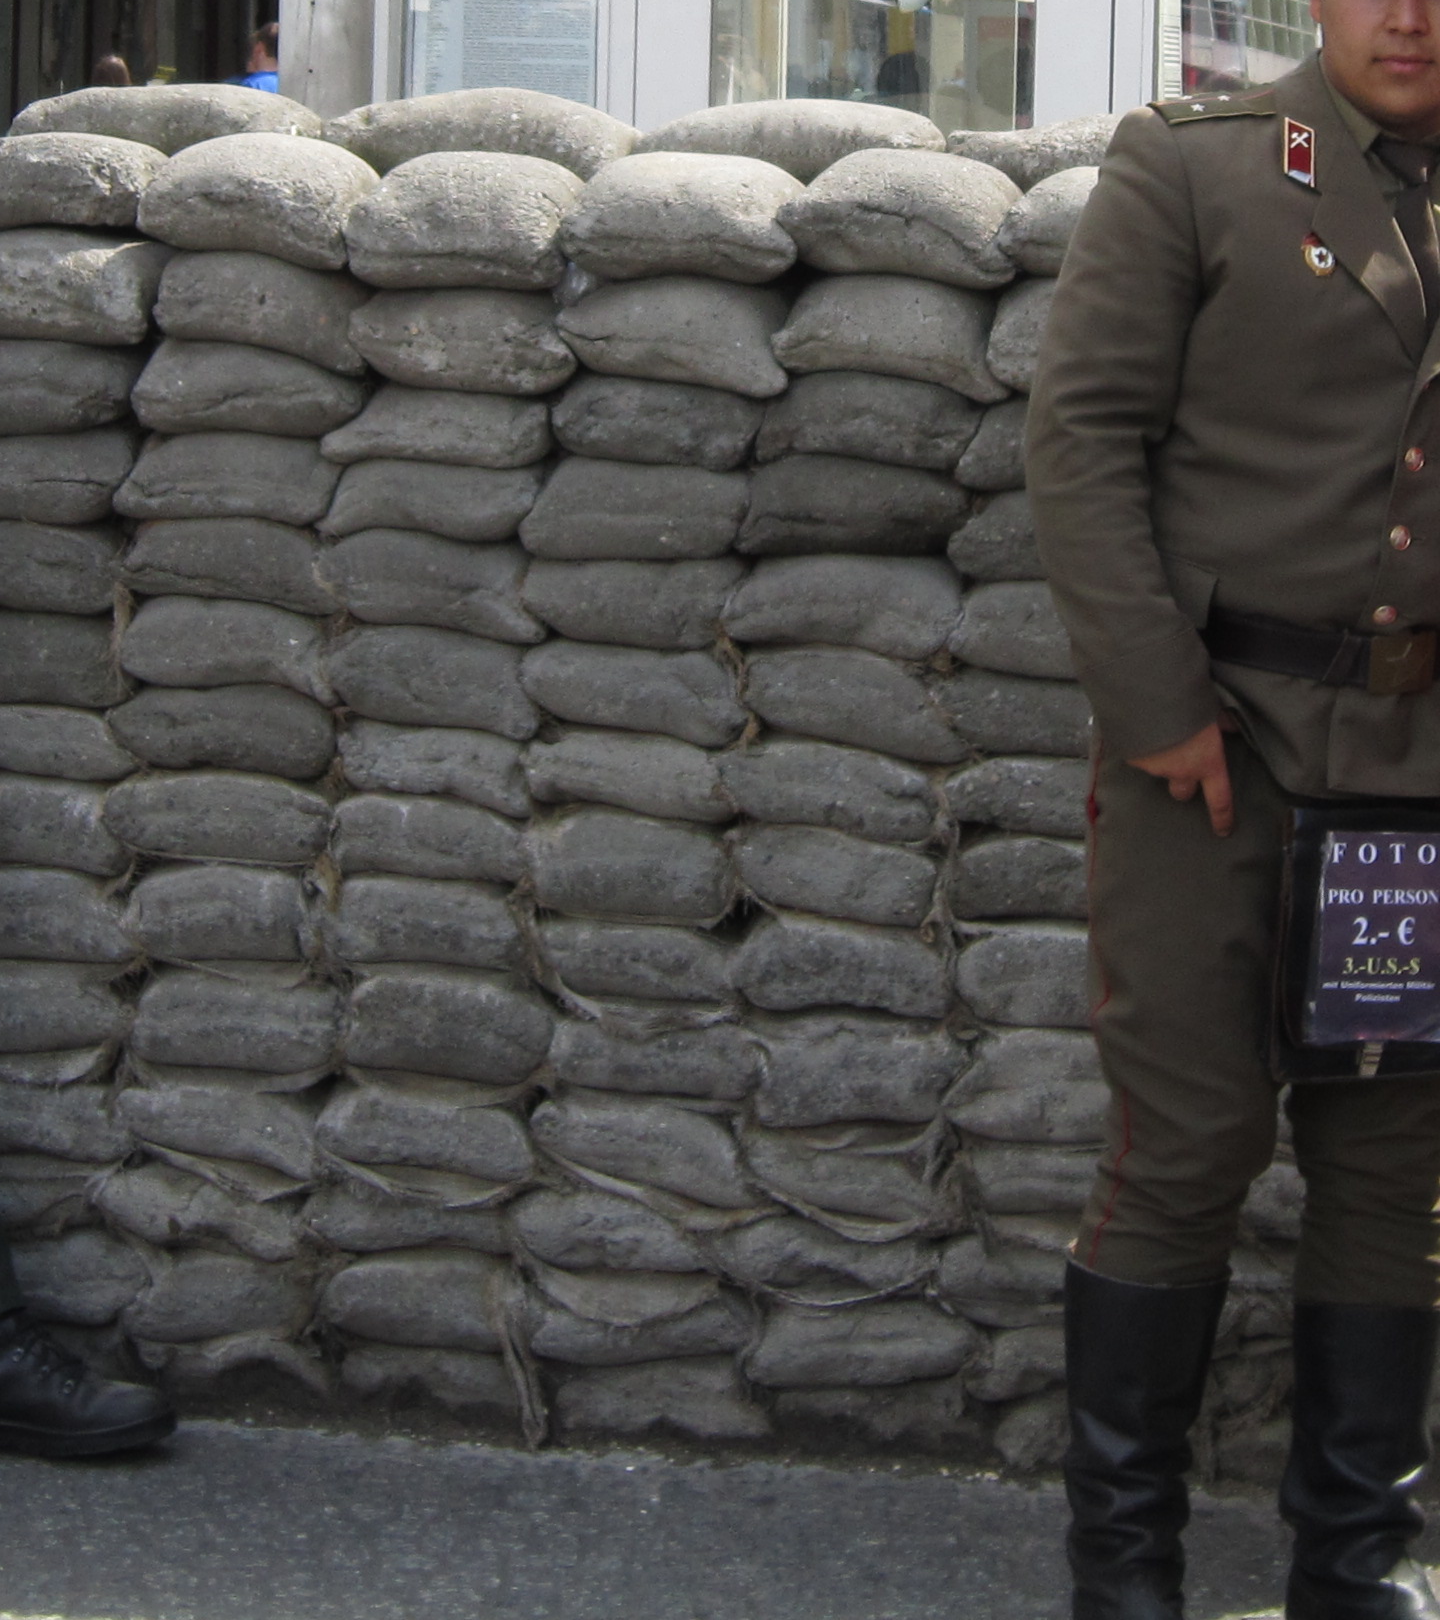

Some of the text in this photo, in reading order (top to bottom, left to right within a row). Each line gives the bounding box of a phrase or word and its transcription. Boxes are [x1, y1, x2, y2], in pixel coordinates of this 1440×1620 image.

[1327, 888, 1440, 905] PRO PERSON
[1396, 916, 1417, 946] €
